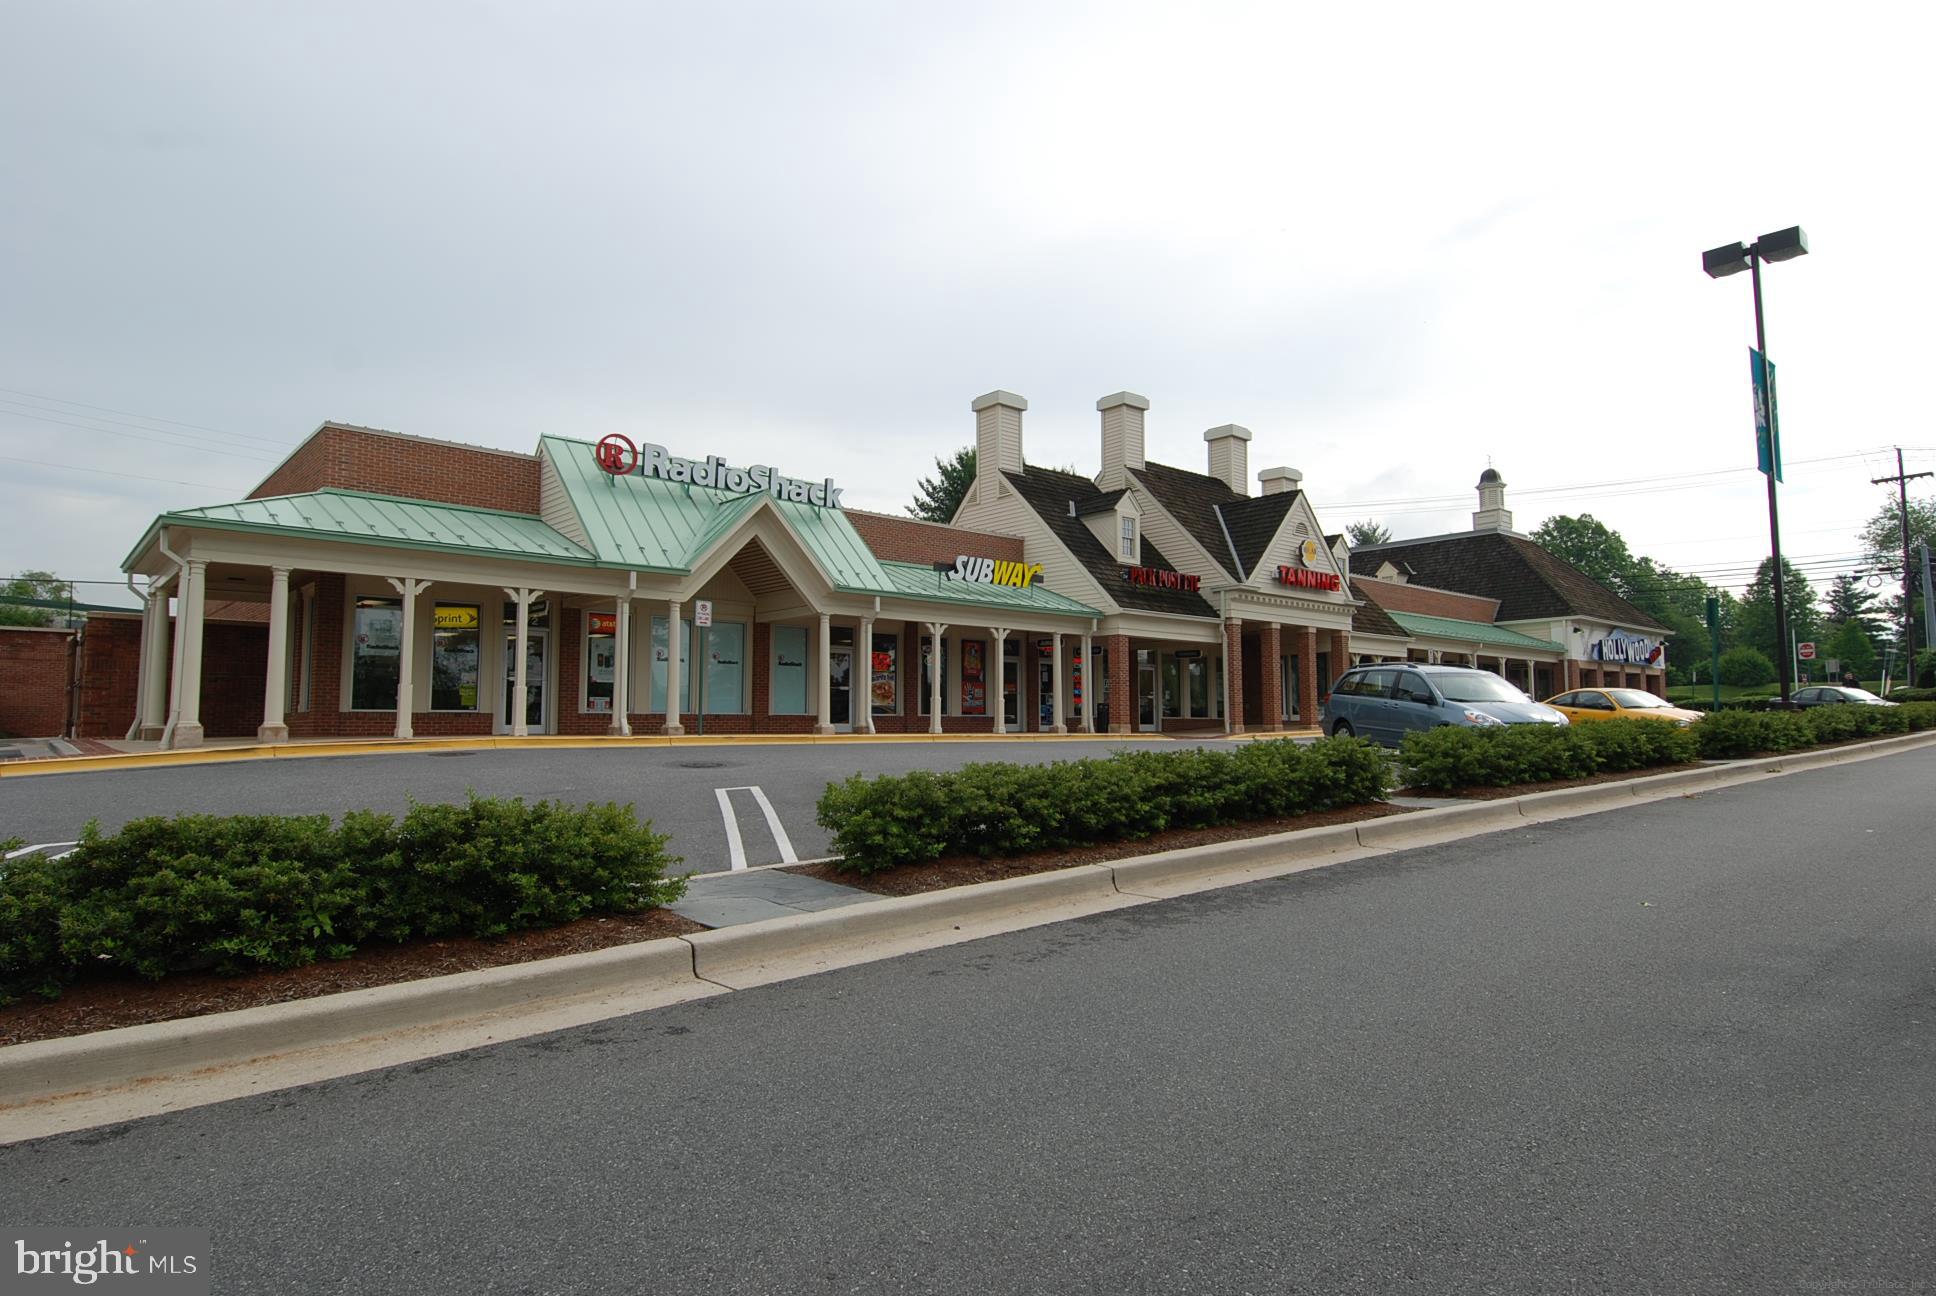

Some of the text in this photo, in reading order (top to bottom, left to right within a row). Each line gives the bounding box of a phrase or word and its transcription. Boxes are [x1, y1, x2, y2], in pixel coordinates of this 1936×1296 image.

[642, 443, 844, 508] RadioShack
[948, 555, 1044, 588] SUBWAY
[1280, 565, 1341, 592] TANNING
